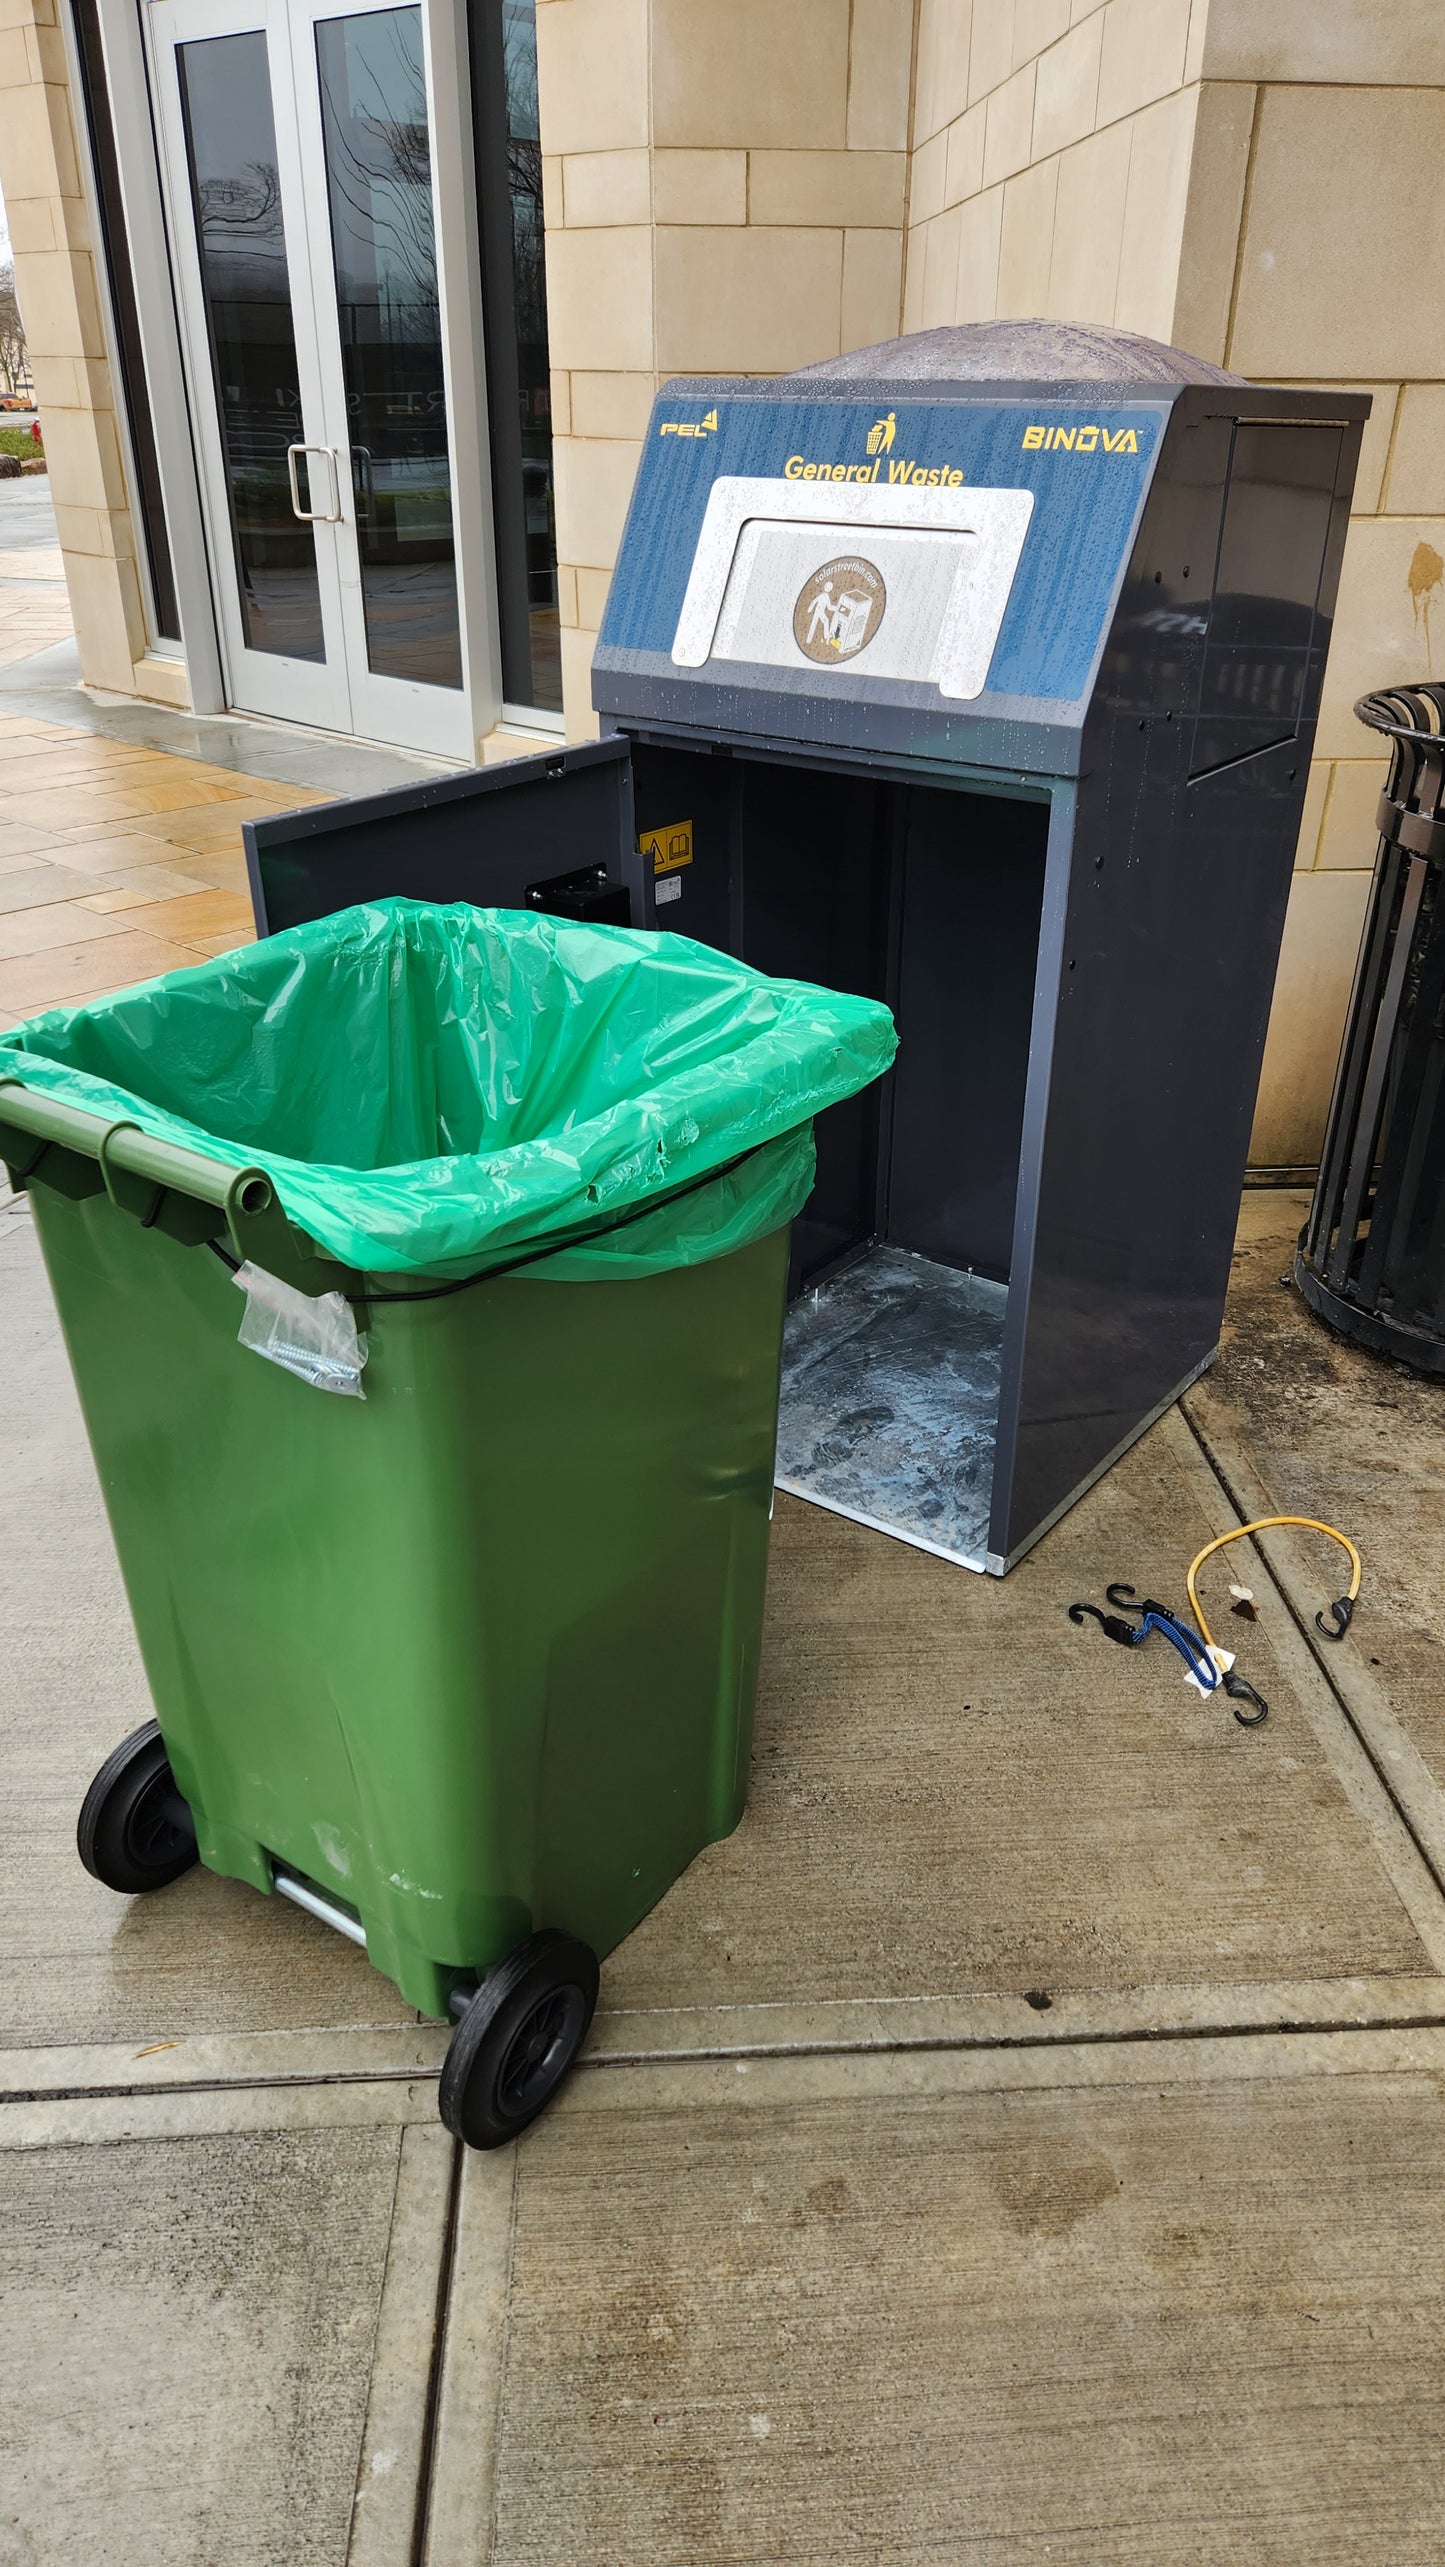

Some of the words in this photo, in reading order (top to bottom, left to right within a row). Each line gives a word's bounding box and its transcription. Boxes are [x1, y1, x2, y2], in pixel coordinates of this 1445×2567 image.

[660, 423, 707, 437] PEL
[1022, 426, 1138, 452] BINOVA
[784, 455, 881, 483] General
[888, 459, 963, 487] Waste
[815, 562, 878, 588] solarstreetbin.com
